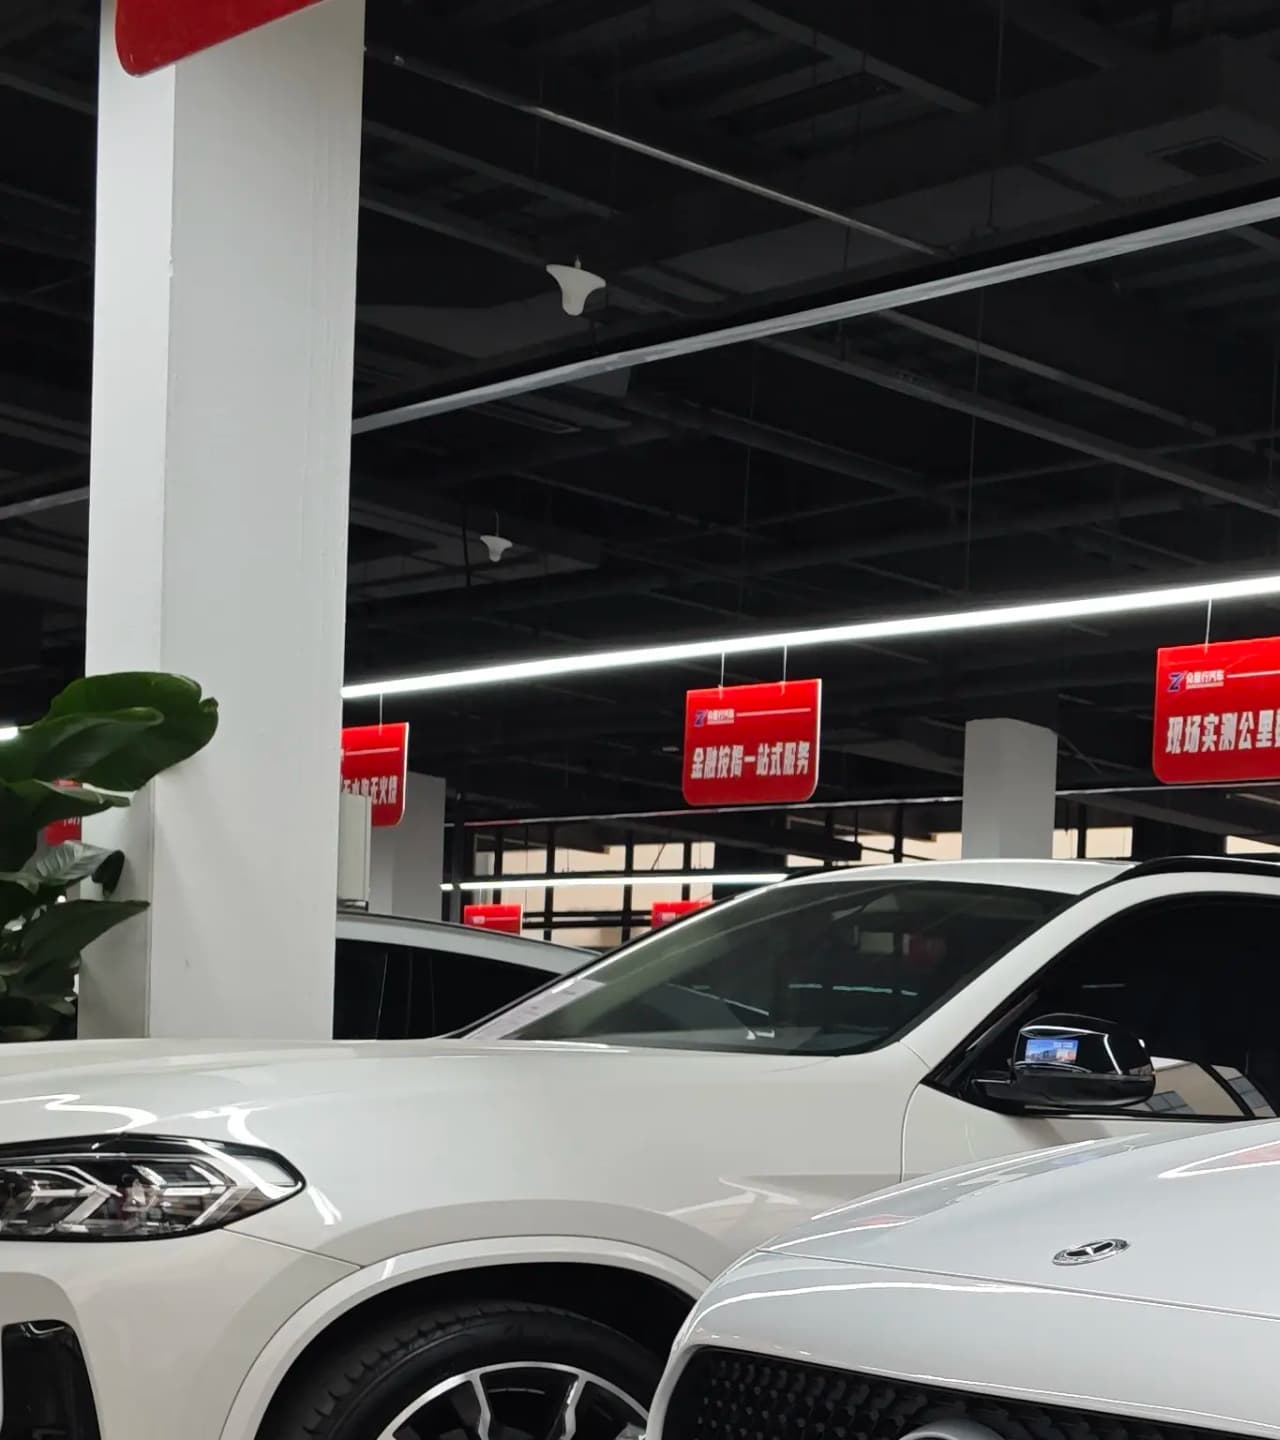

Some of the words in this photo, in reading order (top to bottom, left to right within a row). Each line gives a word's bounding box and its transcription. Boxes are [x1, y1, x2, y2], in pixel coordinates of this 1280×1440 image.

[691, 741, 810, 779] 金融按揭一站式服务
